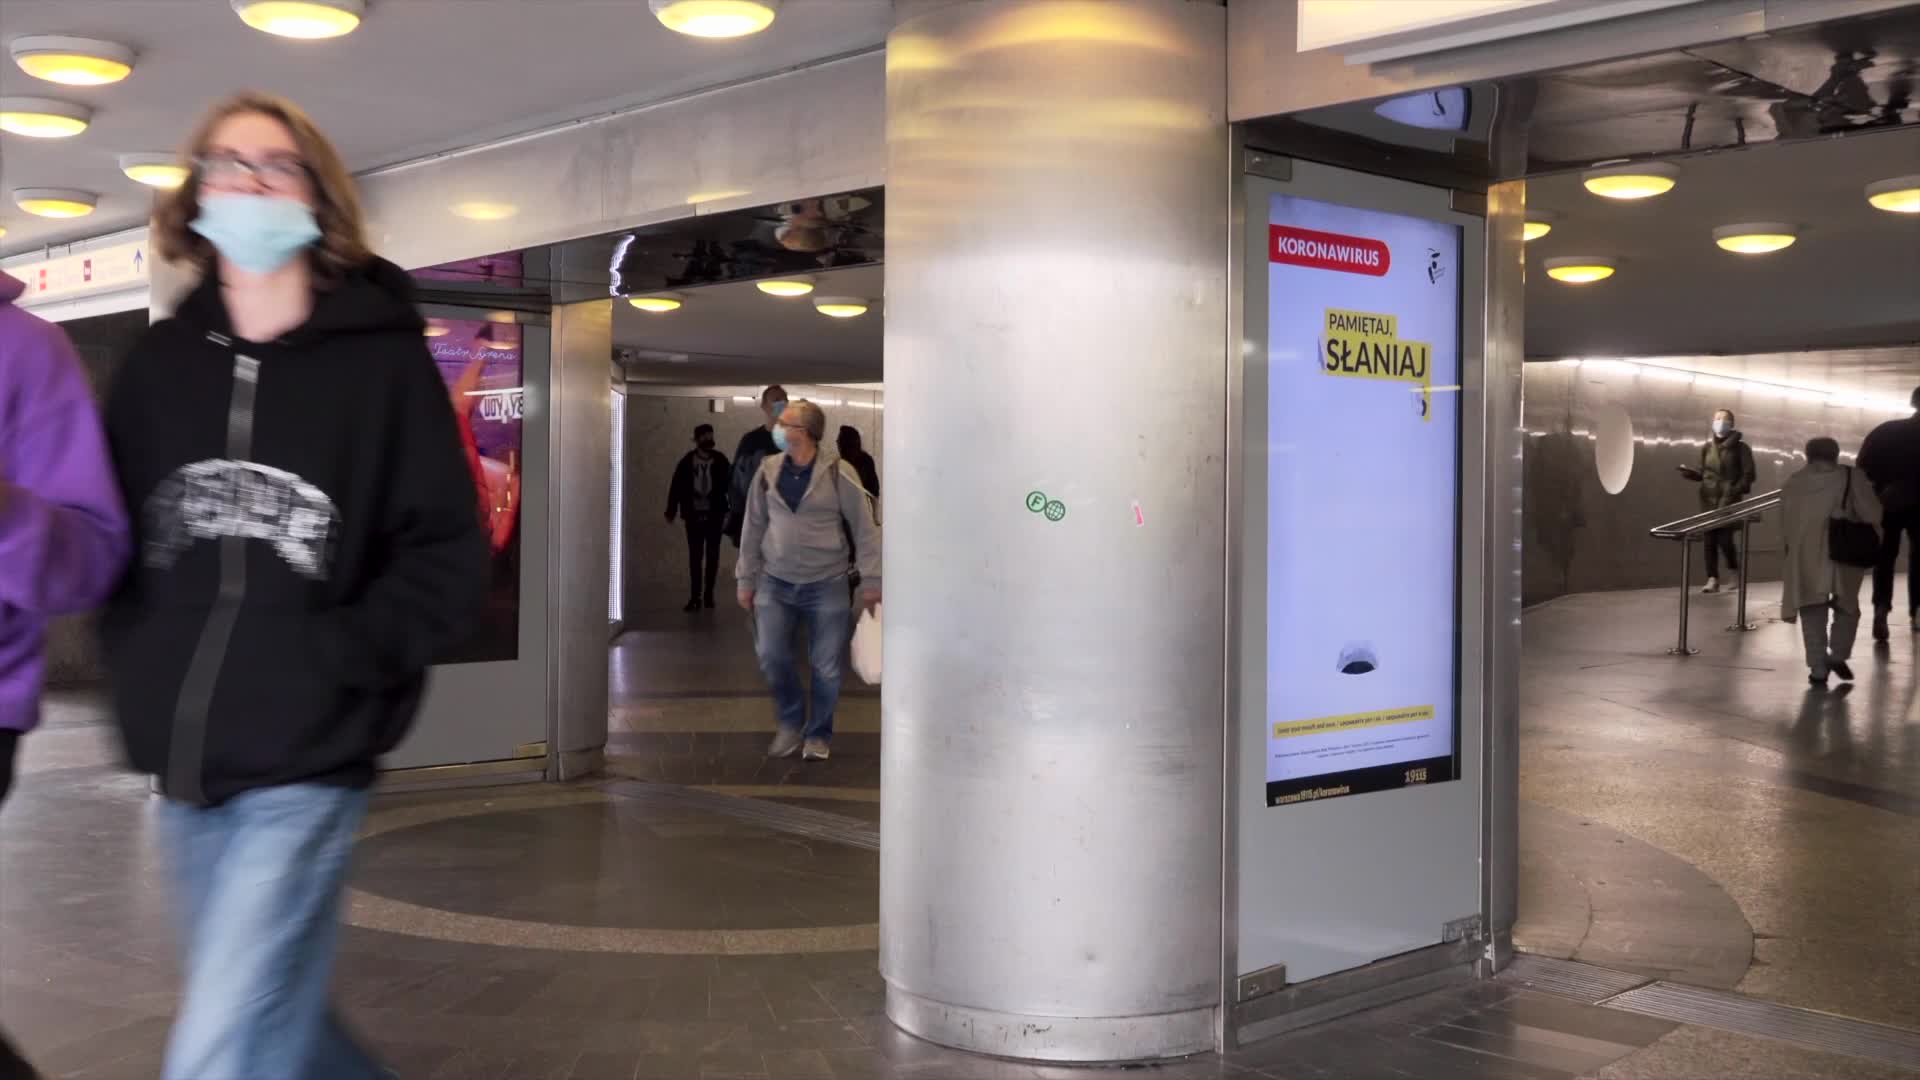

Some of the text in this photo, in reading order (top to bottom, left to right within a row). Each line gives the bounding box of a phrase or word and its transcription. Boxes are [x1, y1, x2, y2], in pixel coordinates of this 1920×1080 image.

[1278, 236, 1380, 267] KORONAWIRUS
[1328, 312, 1393, 337] PAMIĘTAJ,
[1326, 338, 1426, 378] SŁANIAJ
